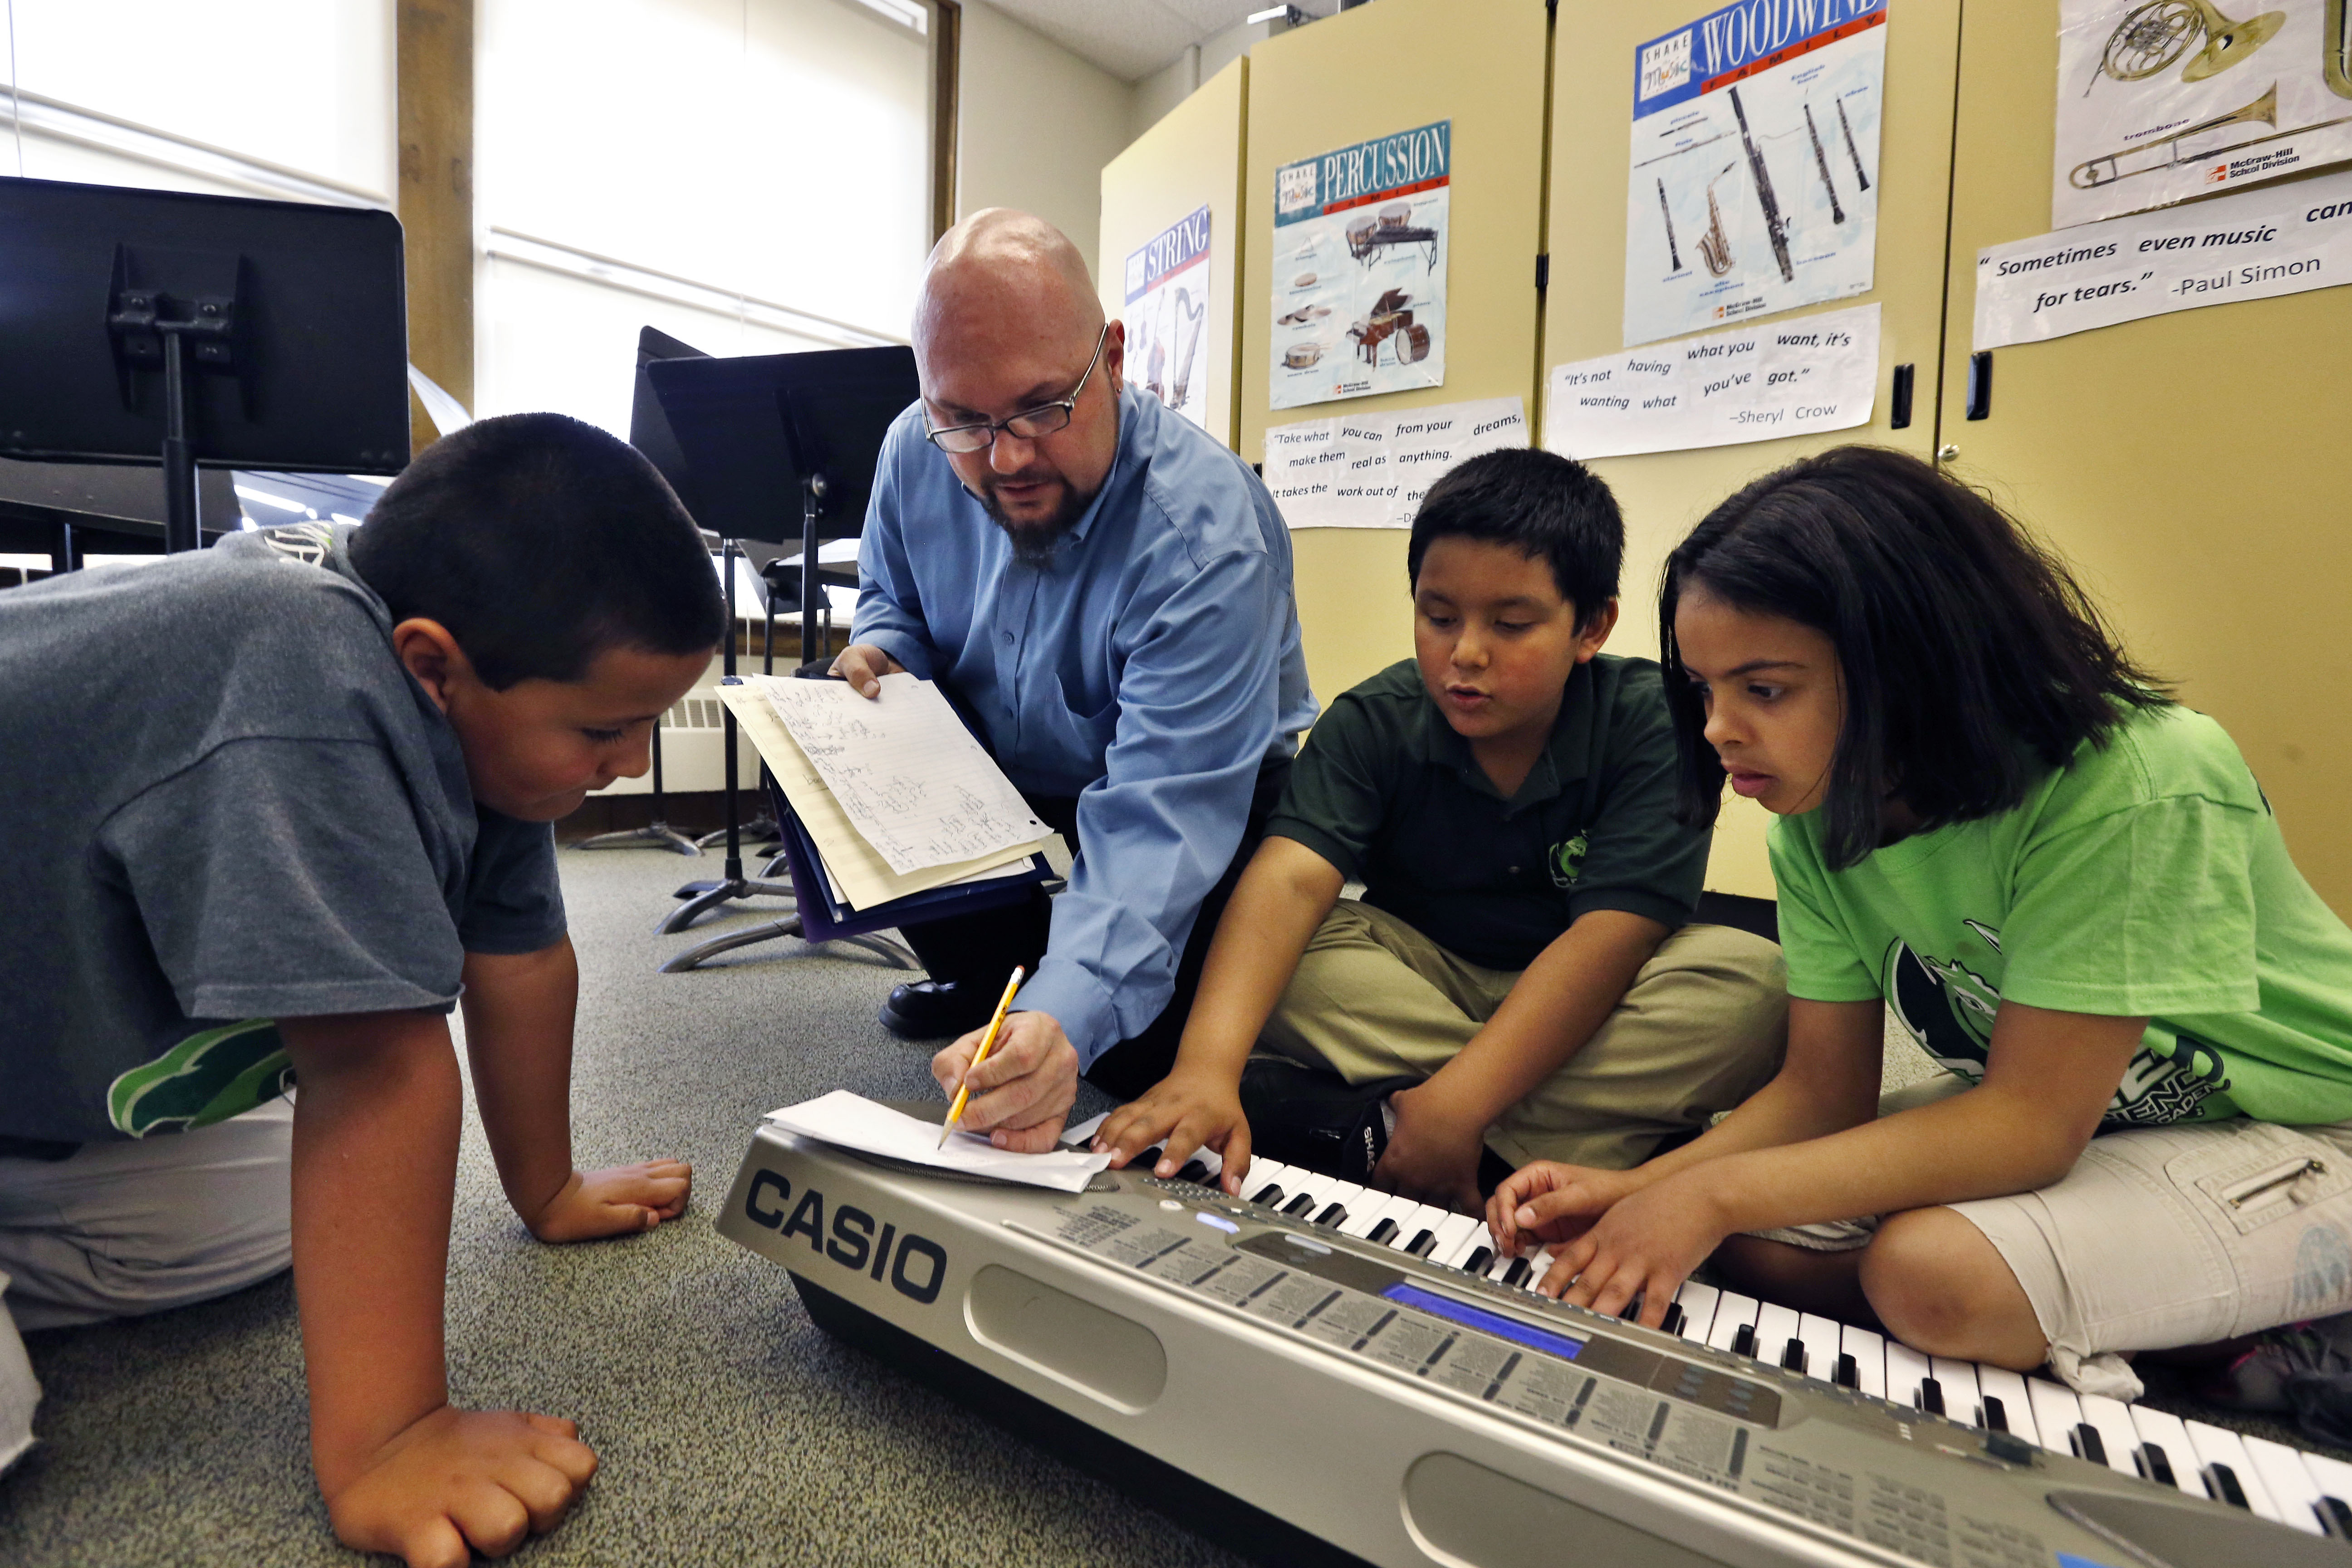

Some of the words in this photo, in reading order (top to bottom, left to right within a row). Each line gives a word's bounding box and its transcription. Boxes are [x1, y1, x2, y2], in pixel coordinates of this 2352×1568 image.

[1646, 34, 1688, 64] SHARE
[1703, 0, 1878, 75] WOODW
[1710, 15, 1877, 89] FAMILY
[1323, 125, 1446, 202] PERCUSSION
[2230, 147, 2293, 170] McGraw-Hill
[2230, 165, 2259, 179] School
[2262, 155, 2300, 171] Division
[1147, 209, 1208, 281] STRING
[2139, 235, 2196, 252] even
[2202, 225, 2277, 247] music
[2306, 201, 2352, 222] can
[2033, 292, 2068, 313] for
[2171, 270, 2232, 295] -Paul
[2240, 258, 2321, 284] Simon
[1745, 303, 1767, 312] Division
[1591, 369, 1612, 382] not
[1627, 359, 1671, 376] having
[1687, 345, 1725, 359] what
[1727, 341, 1755, 357] you
[1777, 334, 1820, 348] want,
[1826, 333, 1851, 346] it’s
[1580, 395, 1630, 410] wanting
[1643, 395, 1677, 409] what
[1704, 372, 1752, 397] you’ve
[1304, 431, 1330, 442] what
[1341, 426, 1362, 437] you
[1363, 431, 1383, 441] can
[1395, 424, 1423, 437] from
[1426, 420, 1453, 433] your
[1473, 414, 1521, 436] dreams,
[1795, 405, 1838, 419] Crow
[1289, 455, 1316, 467] make
[1319, 451, 1346, 463] them
[1352, 456, 1372, 470] real
[1375, 455, 1387, 464] as
[1399, 450, 1452, 464] anything.
[1272, 489, 1279, 499] It
[1282, 486, 1308, 498] takes
[1312, 483, 1328, 494] the
[1337, 486, 1364, 497] work
[1366, 487, 1384, 496] out
[1387, 485, 1400, 498] of
[1407, 490, 1425, 500] the
[745, 1169, 947, 1304] CASIO
